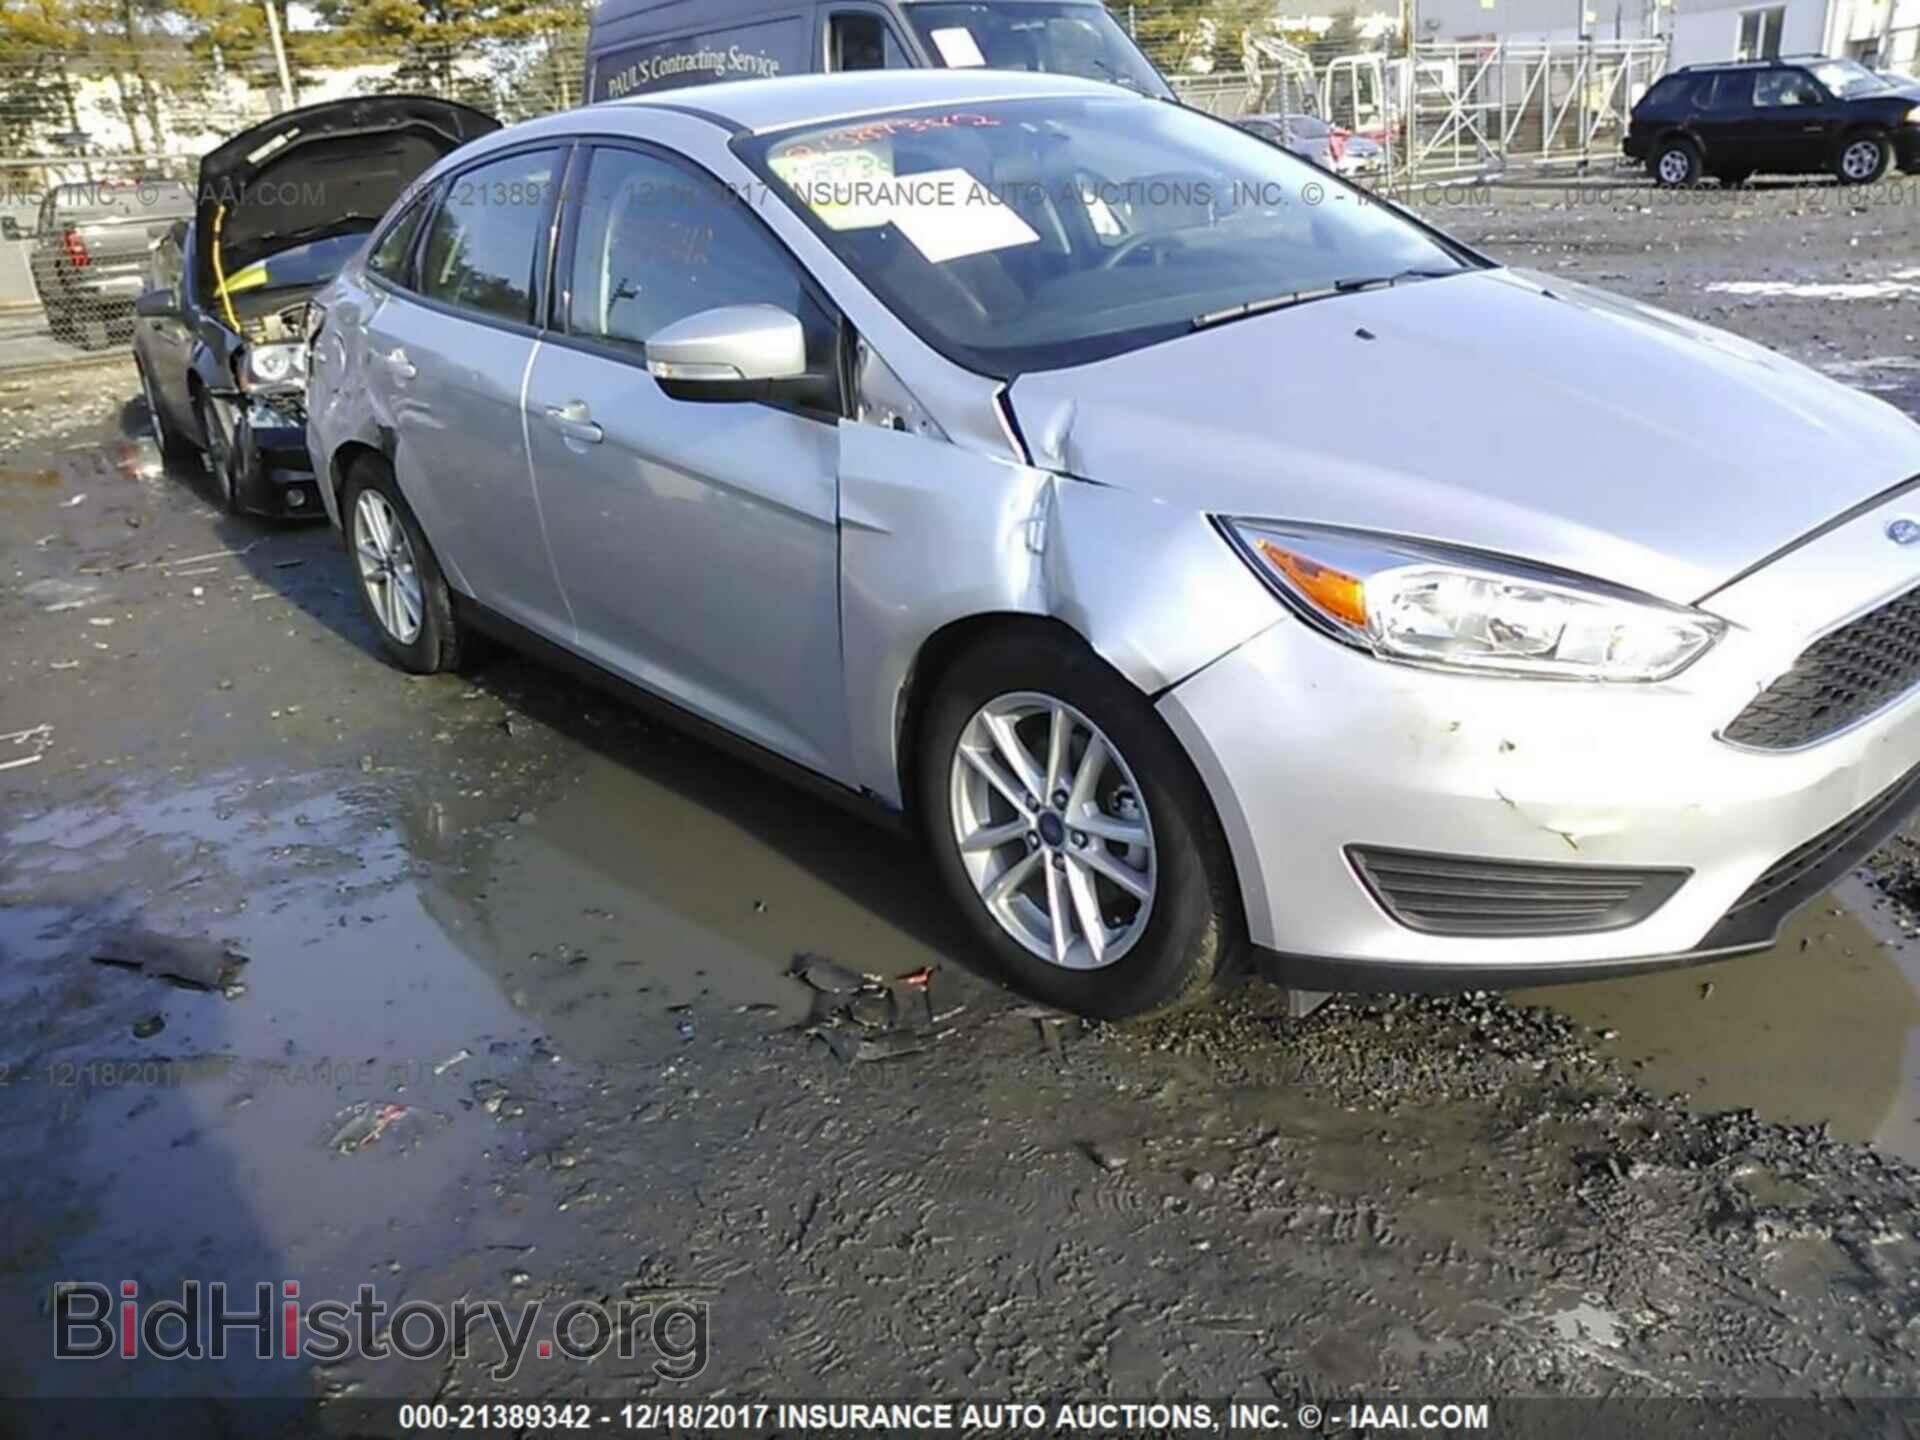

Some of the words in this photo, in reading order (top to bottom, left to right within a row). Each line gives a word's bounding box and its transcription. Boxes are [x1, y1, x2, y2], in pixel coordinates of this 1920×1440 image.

[607, 59, 650, 98] PAUL'S
[651, 46, 726, 76] Contracting
[728, 45, 780, 78] Service
